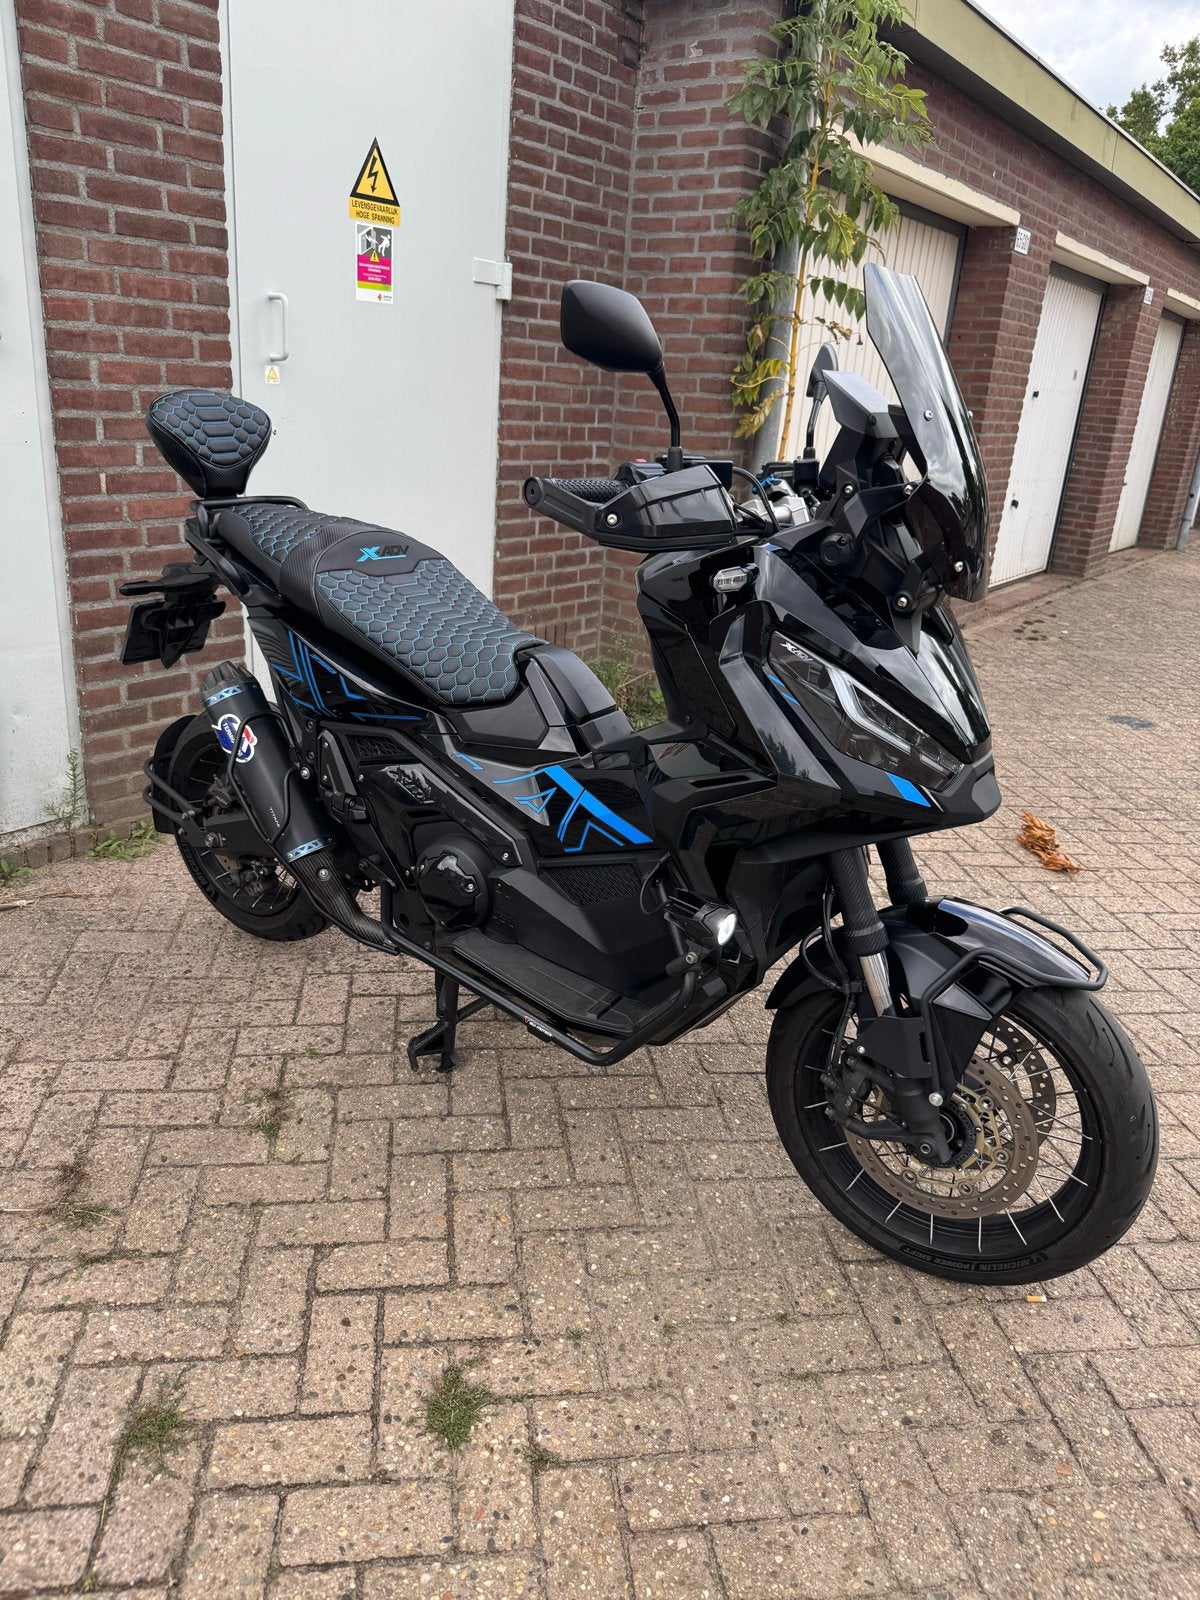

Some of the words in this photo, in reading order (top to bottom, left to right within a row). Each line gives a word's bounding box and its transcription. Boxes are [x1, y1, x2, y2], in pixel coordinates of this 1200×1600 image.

[352, 200, 398, 215] LEVENSGEVAARLIJK
[356, 211, 370, 220] HOGE
[372, 213, 394, 224] SPANNING
[904, 1247, 932, 1262] SHIFT
[934, 1258, 970, 1270] POWER
[979, 1256, 1031, 1271] MICHELIN
